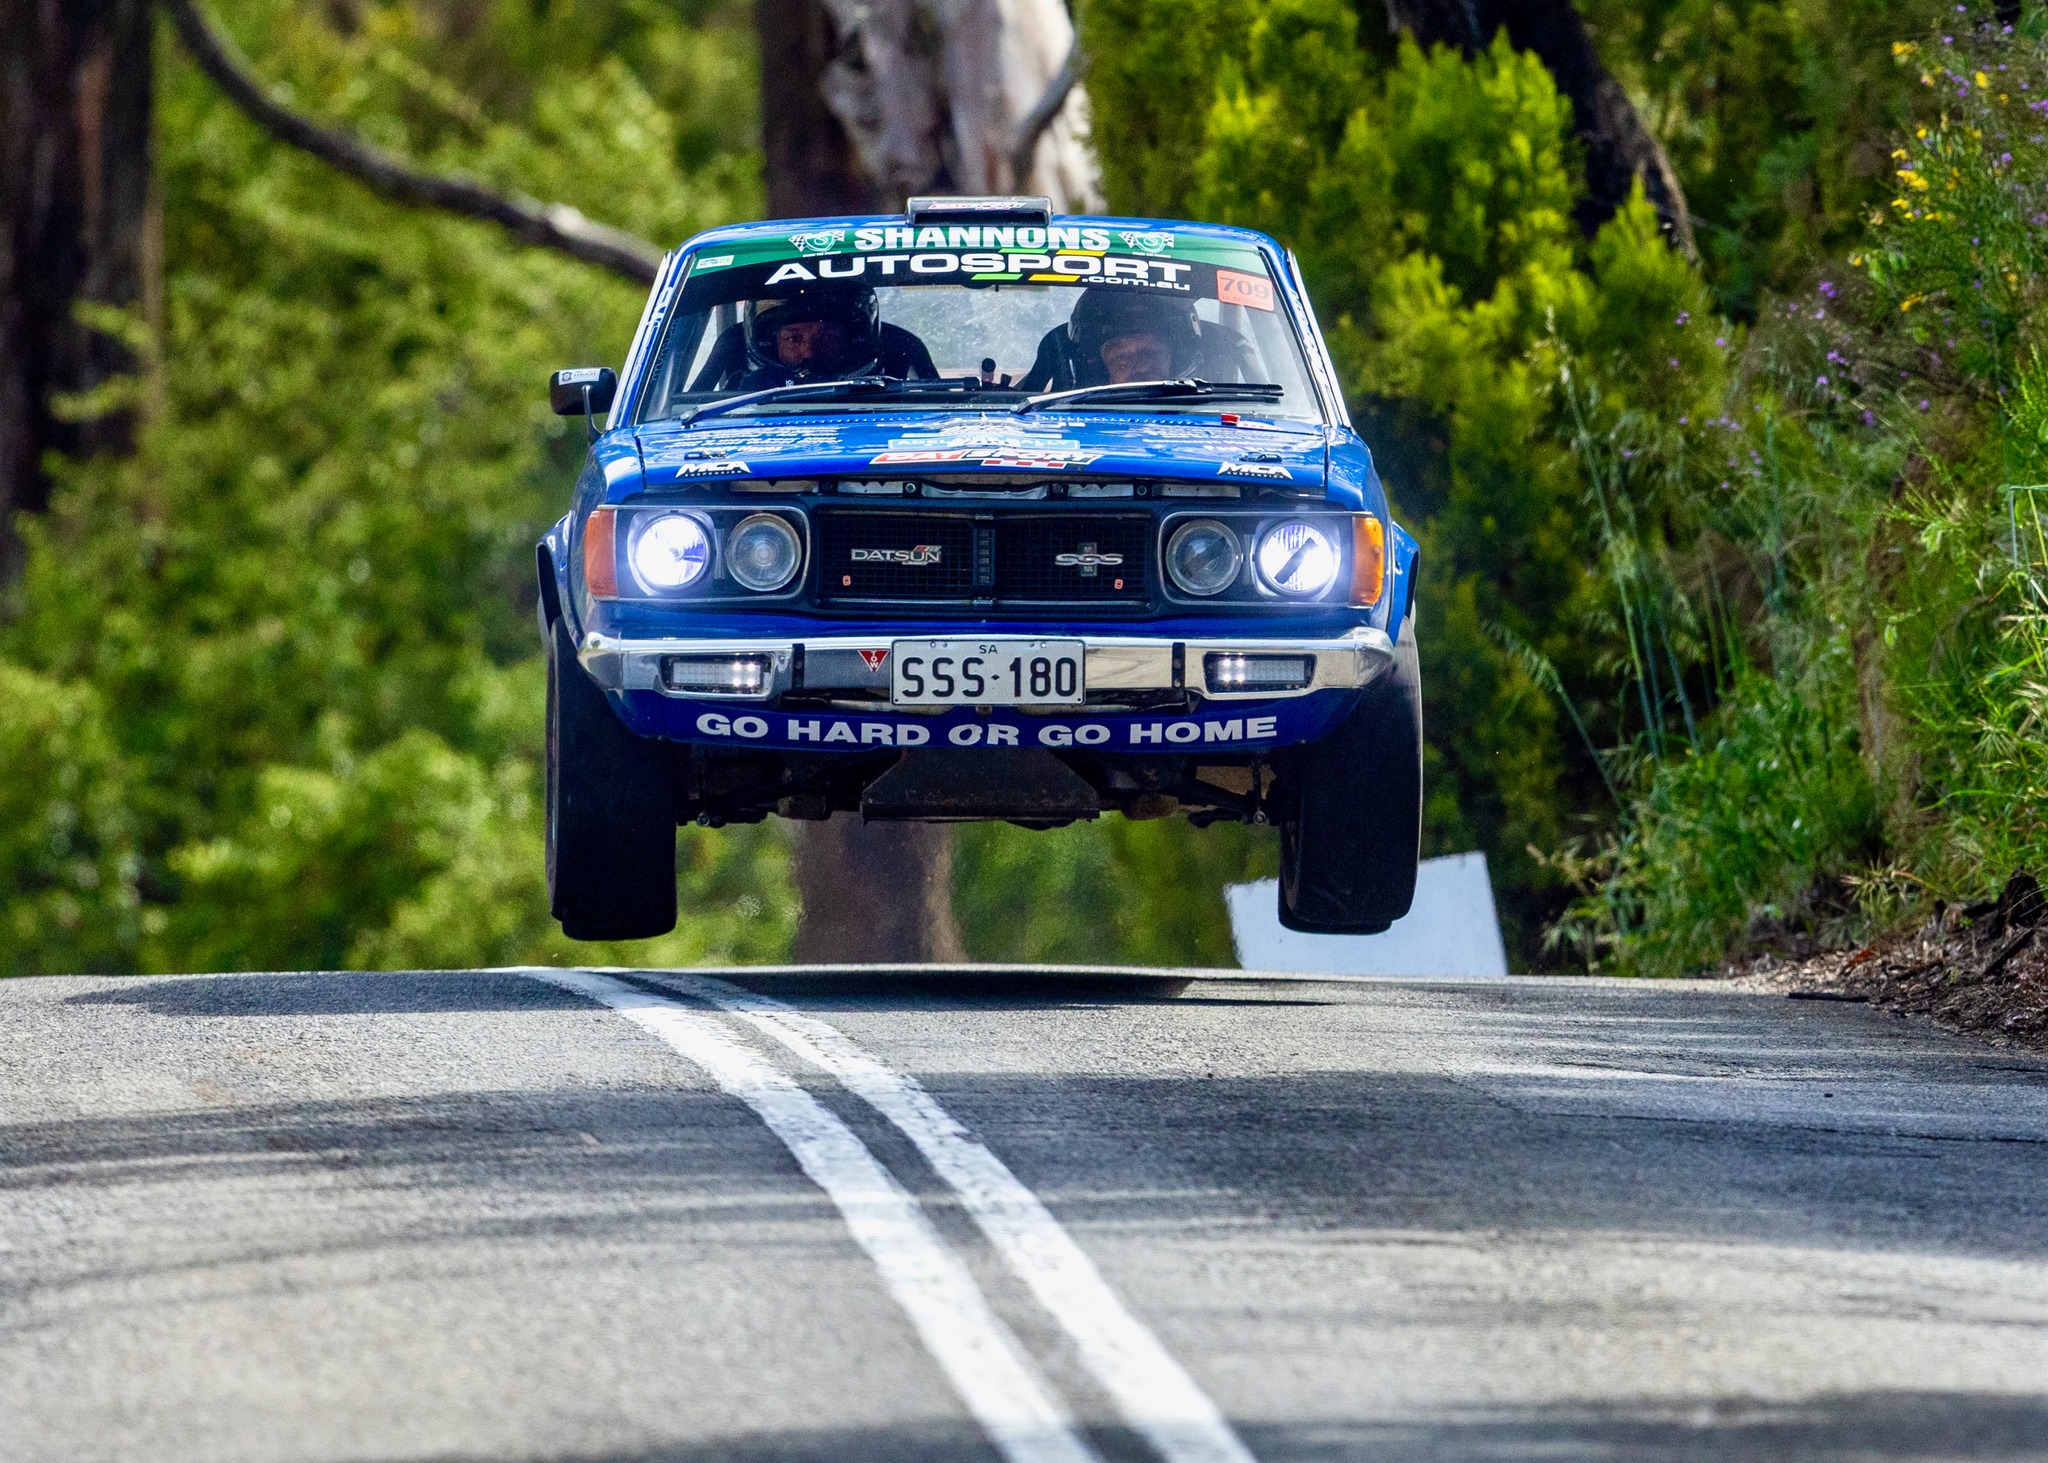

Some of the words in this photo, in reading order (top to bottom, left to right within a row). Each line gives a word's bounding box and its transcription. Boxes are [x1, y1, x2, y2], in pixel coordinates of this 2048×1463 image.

[854, 226, 1110, 250] SHANNONS
[764, 253, 1191, 285] AUTOSPORT
[1081, 275, 1191, 291] .com.au
[1220, 276, 1269, 299] 709
[675, 461, 751, 478] MCA
[1217, 461, 1293, 480] MCA
[851, 549, 941, 562] DATSUN
[1055, 553, 1124, 566] SSS
[979, 644, 998, 654] SA
[869, 651, 879, 669] TOW
[696, 713, 769, 738] GO
[788, 719, 931, 745] HARD
[949, 724, 1019, 746] OR
[1038, 724, 1111, 746] GO
[1130, 716, 1277, 744] HOME
